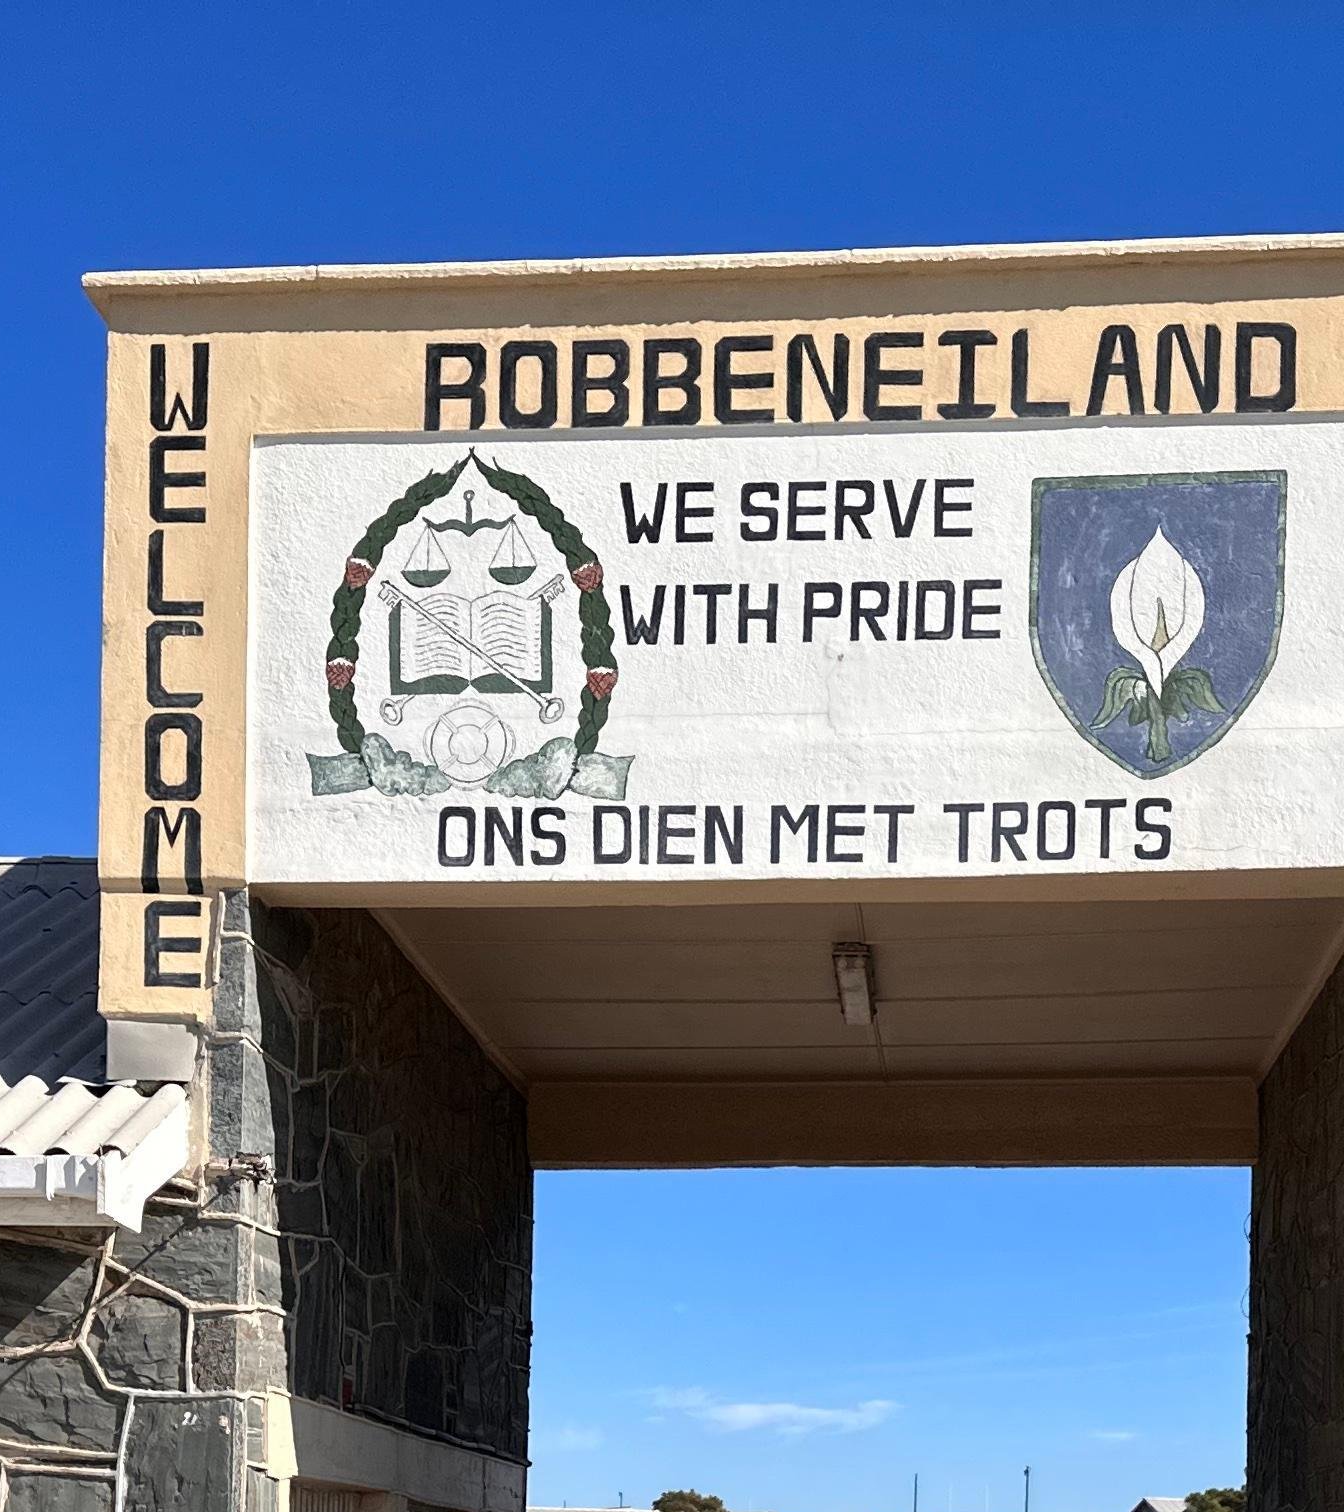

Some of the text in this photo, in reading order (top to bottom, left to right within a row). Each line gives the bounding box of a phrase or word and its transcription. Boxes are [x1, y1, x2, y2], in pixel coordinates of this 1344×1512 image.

[422, 321, 1298, 433] ROBBENEILAND
[618, 477, 976, 545] WE SERVE
[618, 578, 1003, 647] WITH PRIDE
[140, 341, 211, 989] WELCOME
[436, 796, 1173, 868] ONS DIEN MET TROTS
